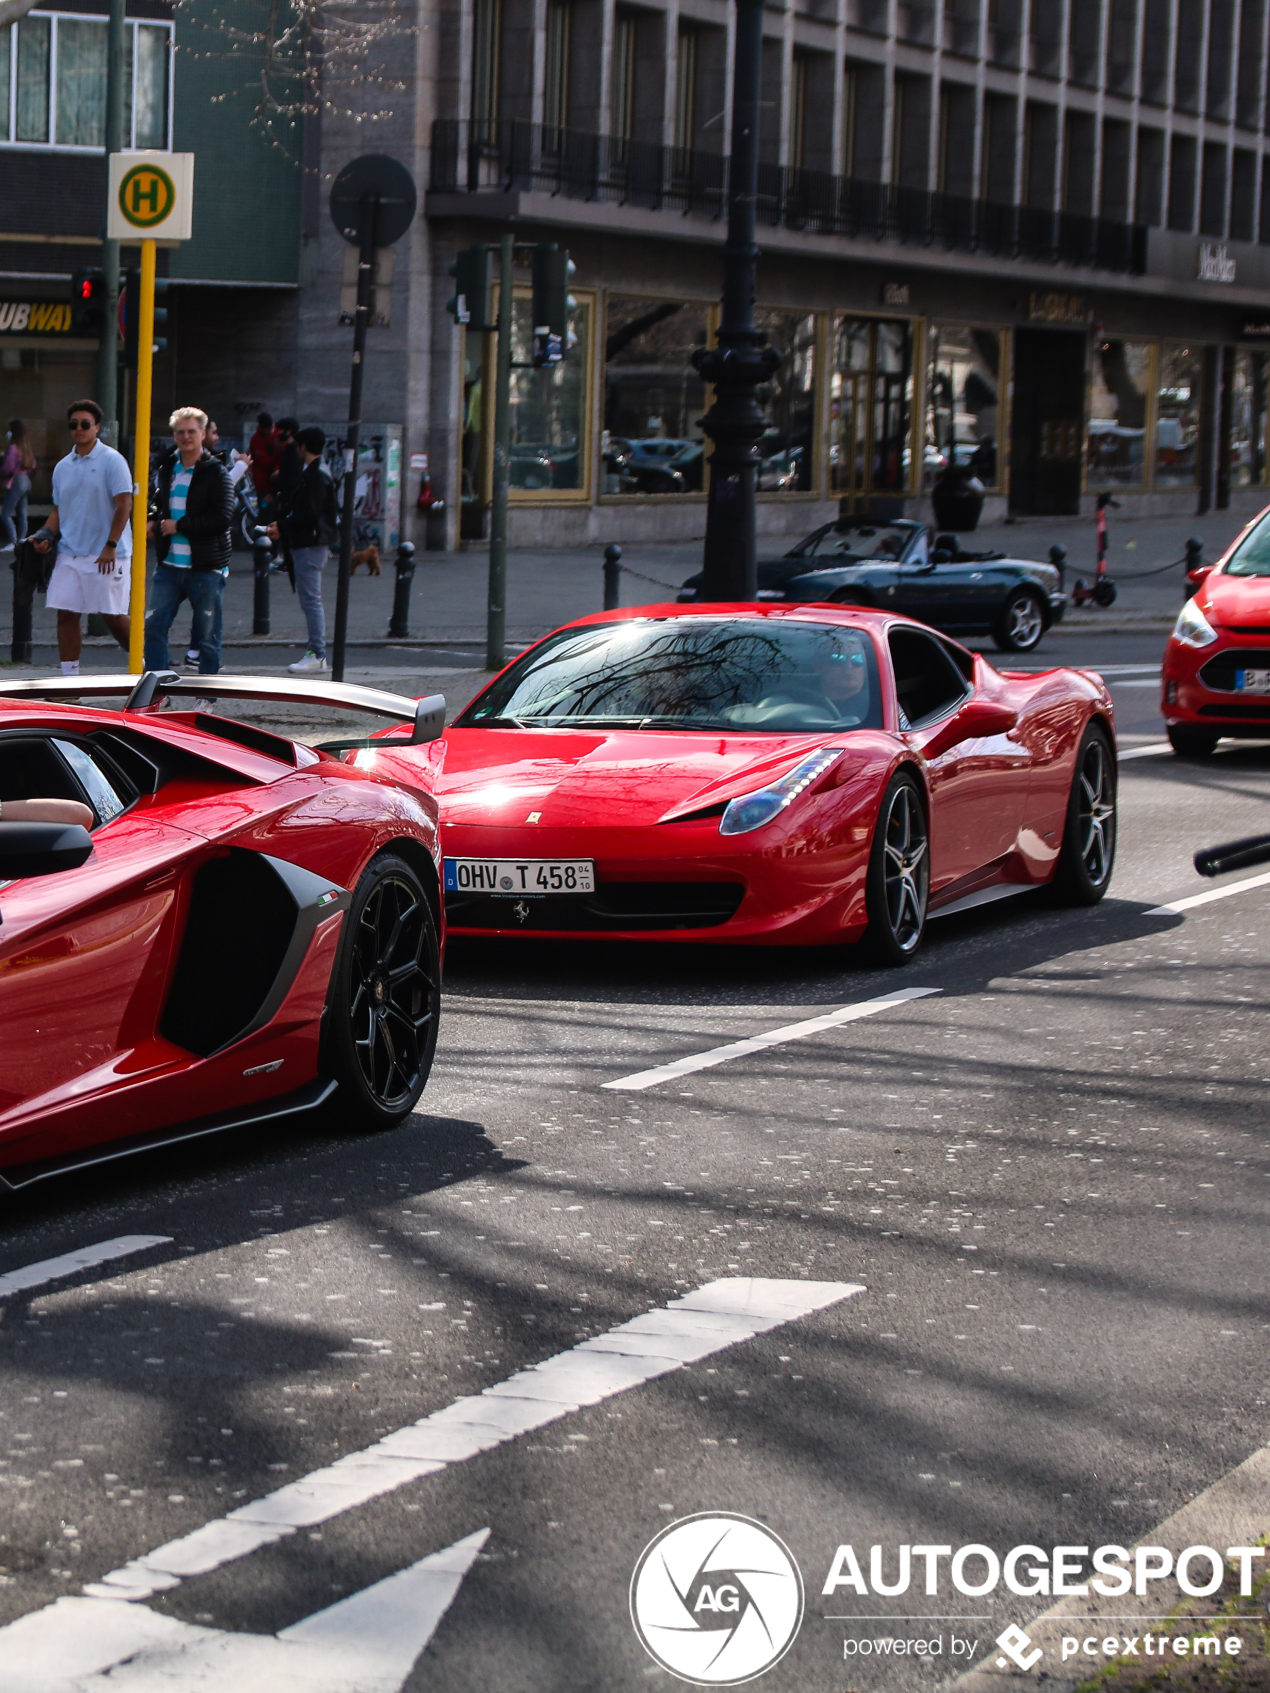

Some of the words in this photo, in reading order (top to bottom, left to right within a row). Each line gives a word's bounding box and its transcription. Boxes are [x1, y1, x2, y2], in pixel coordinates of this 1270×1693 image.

[132, 178, 158, 213] H
[458, 864, 497, 888] OHV
[516, 865, 528, 889] T
[536, 865, 577, 890] 458
